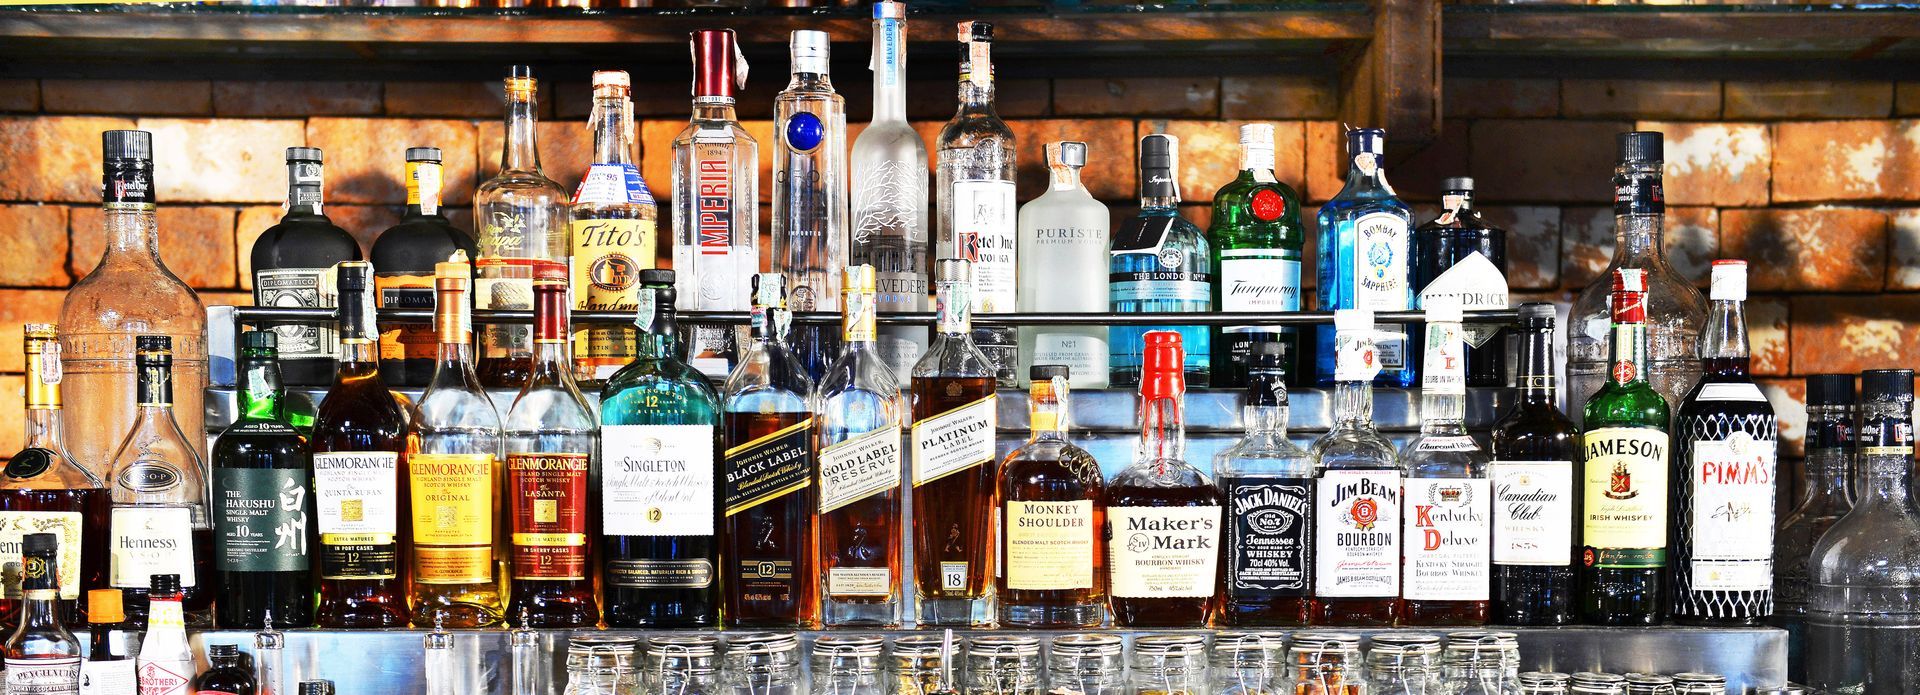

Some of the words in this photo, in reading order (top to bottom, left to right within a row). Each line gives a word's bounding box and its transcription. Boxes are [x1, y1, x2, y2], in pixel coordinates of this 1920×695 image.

[606, 173, 618, 181] 95
[700, 159, 729, 255] IMPERIA
[582, 222, 647, 248] Tito's
[1363, 223, 1398, 240] BOMBAY
[958, 231, 995, 263] Ketel
[262, 278, 316, 288] DIPLOMATICO
[1133, 272, 1150, 280] THE
[1230, 280, 1298, 298] Tanqueray
[1361, 277, 1398, 292] SAPPHIRE
[384, 295, 434, 304] DIPLOMAT
[878, 294, 912, 304] VODKA
[646, 395, 659, 408] 12
[259, 422, 269, 430] 10
[921, 419, 989, 450] PLATINUM
[943, 435, 974, 450] LABEL
[736, 452, 763, 468] JOHNNIE
[763, 443, 789, 456] WALKER
[1584, 438, 1662, 463] JAMESON
[315, 457, 395, 470] GLENMORANGIE
[507, 457, 588, 471] GLENMORANGIE
[726, 461, 766, 483] BLACK
[768, 447, 808, 467] LABEL
[823, 459, 856, 478] GOLD
[857, 444, 897, 465] LABEL
[411, 463, 489, 476] GLENMORANGIE
[831, 454, 896, 485] RESERVE
[1702, 455, 1769, 485] PIMM'S
[225, 490, 242, 498] THE
[525, 490, 566, 498] LASANTA
[1331, 482, 1358, 507] JIM
[1361, 477, 1396, 505] BEAM
[1496, 483, 1557, 502] Canadian
[226, 499, 275, 509] HAKUSHU
[1234, 491, 1264, 516] JACK
[1264, 487, 1308, 516] DANIEL'S
[648, 509, 661, 521] 12
[1024, 503, 1079, 515] MONKEY
[1361, 507, 1370, 517] B
[1415, 505, 1485, 527] Kentucky
[1508, 502, 1544, 521] Club
[275, 477, 307, 556] 白州
[1019, 516, 1084, 528] SHOULDER
[1127, 516, 1213, 531] Maker's
[1259, 517, 1281, 526] No.7
[1614, 514, 1653, 522] WHISKEY
[236, 524, 250, 537] 10
[120, 535, 178, 551] Hennessy
[1152, 535, 1212, 550] Mark
[1245, 533, 1294, 546] Tennessee
[1337, 532, 1392, 547] BOURBON
[1424, 530, 1478, 551] Deluxe
[347, 552, 360, 563] 12
[540, 555, 553, 565] 12
[1246, 550, 1293, 558] WHISKEY
[1175, 558, 1206, 566] WHISKY
[1249, 558, 1263, 567] 70cl
[1264, 559, 1278, 567] 40%
[1279, 558, 1290, 567] Vol.
[762, 564, 773, 575] 12
[947, 573, 961, 587] 18
